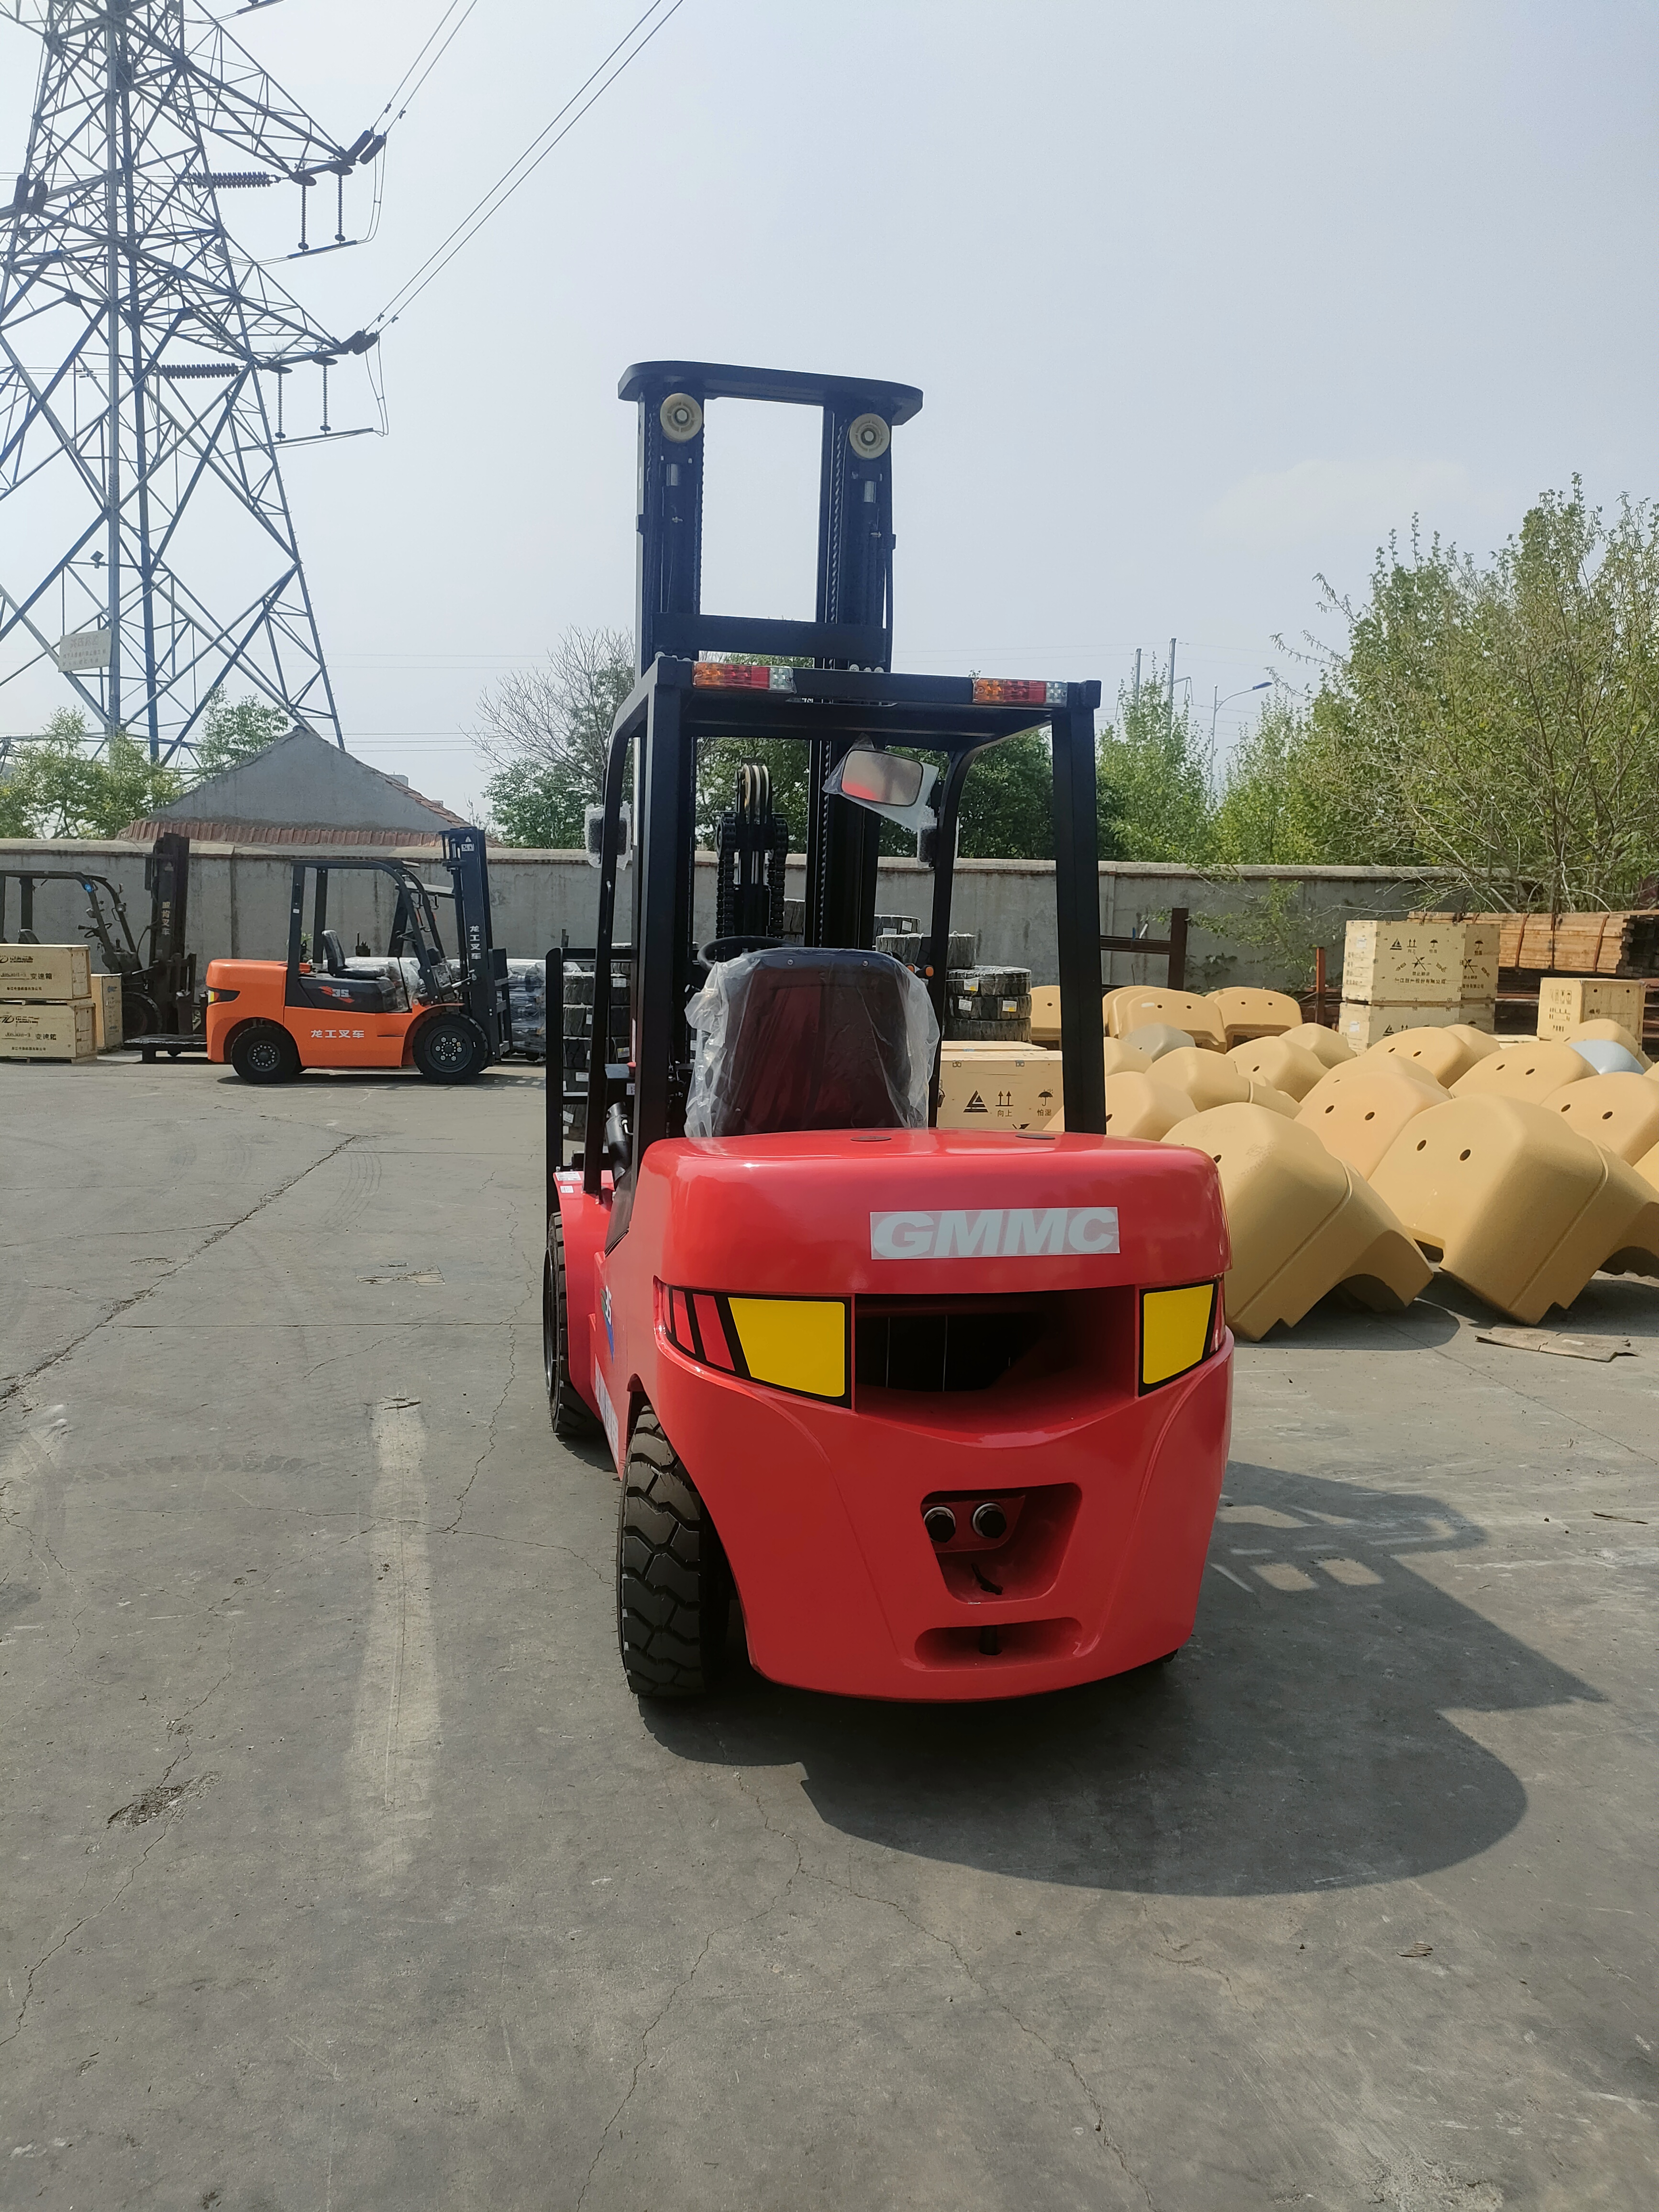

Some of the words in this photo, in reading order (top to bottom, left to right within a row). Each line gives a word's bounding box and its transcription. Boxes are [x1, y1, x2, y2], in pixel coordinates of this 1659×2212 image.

[469, 926, 482, 960] 龙工叉车
[332, 988, 349, 997] 35
[310, 1029, 365, 1039] 龙工叉车
[873, 1207, 1118, 1259] GMMC
